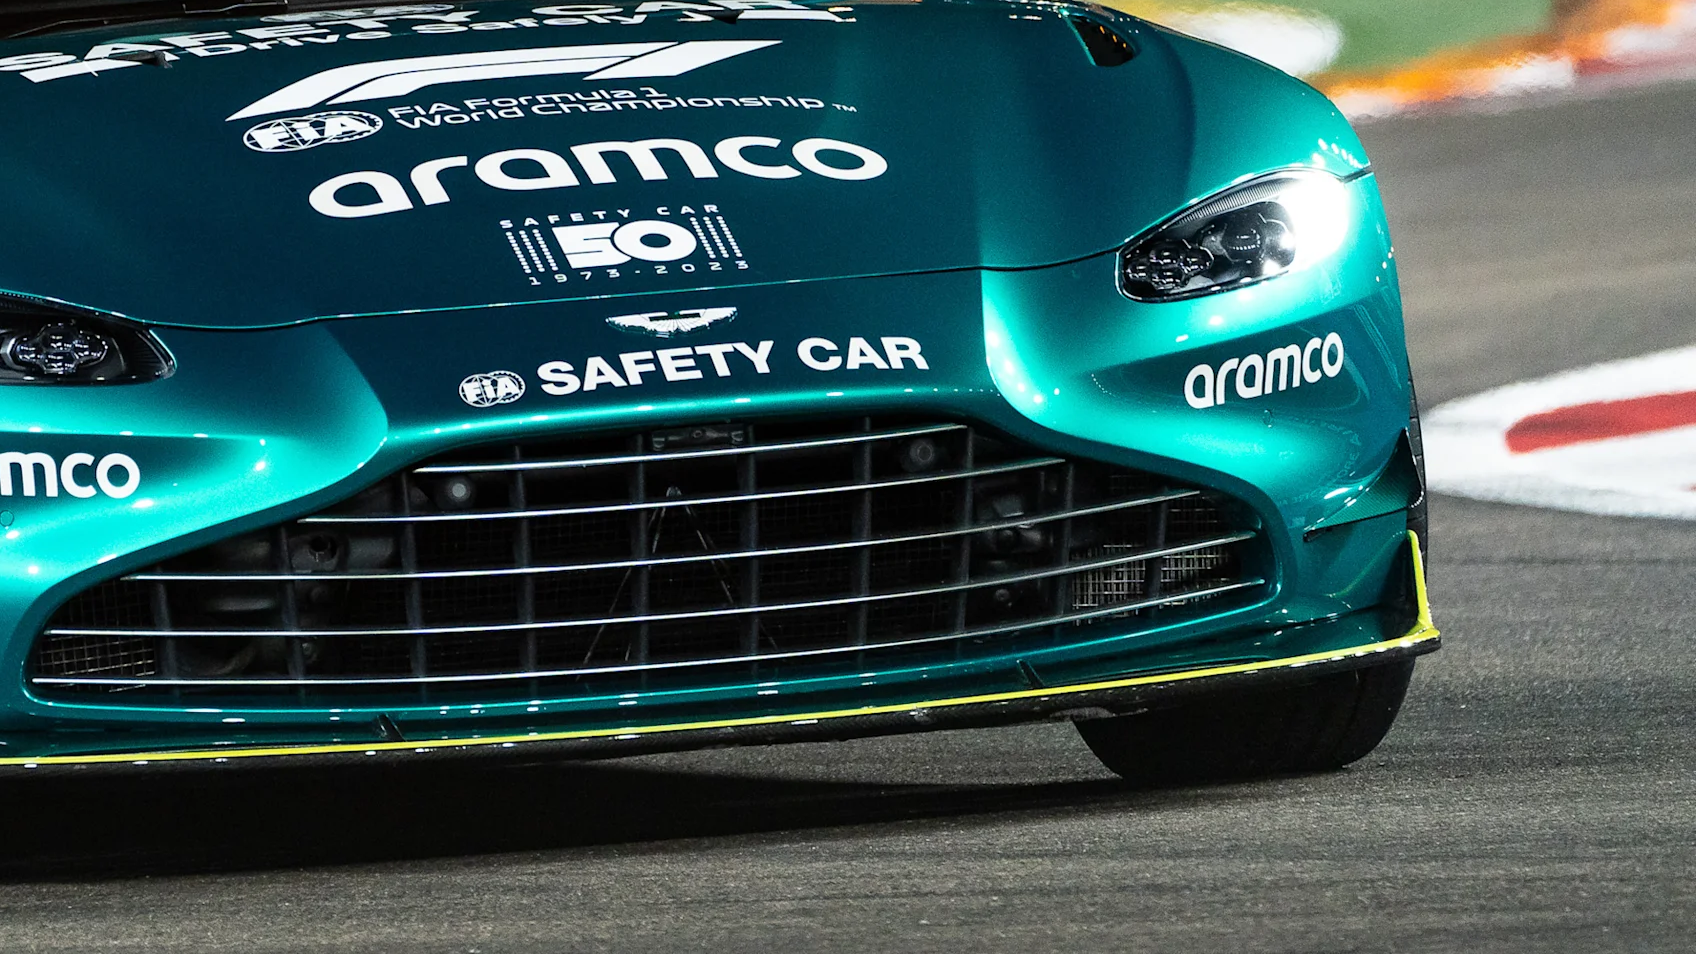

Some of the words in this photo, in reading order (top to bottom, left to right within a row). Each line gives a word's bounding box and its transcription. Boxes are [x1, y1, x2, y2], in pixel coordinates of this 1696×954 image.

[532, 0, 812, 16] CAR
[183, 31, 392, 58] Drive
[411, 13, 648, 34] Safely
[387, 103, 458, 118] FIA
[463, 87, 639, 110] Formula
[395, 106, 525, 129] World
[529, 96, 825, 115] Championship
[248, 116, 373, 151] FIA
[308, 136, 888, 218] aramco
[499, 208, 631, 230] SAFETY
[655, 204, 719, 216] CAR
[551, 219, 698, 270] 50
[528, 259, 749, 286] 1973-2023
[461, 375, 523, 405] FIA
[536, 340, 774, 396] SAFETY
[797, 336, 930, 372] CAR
[1184, 332, 1345, 409] aramco
